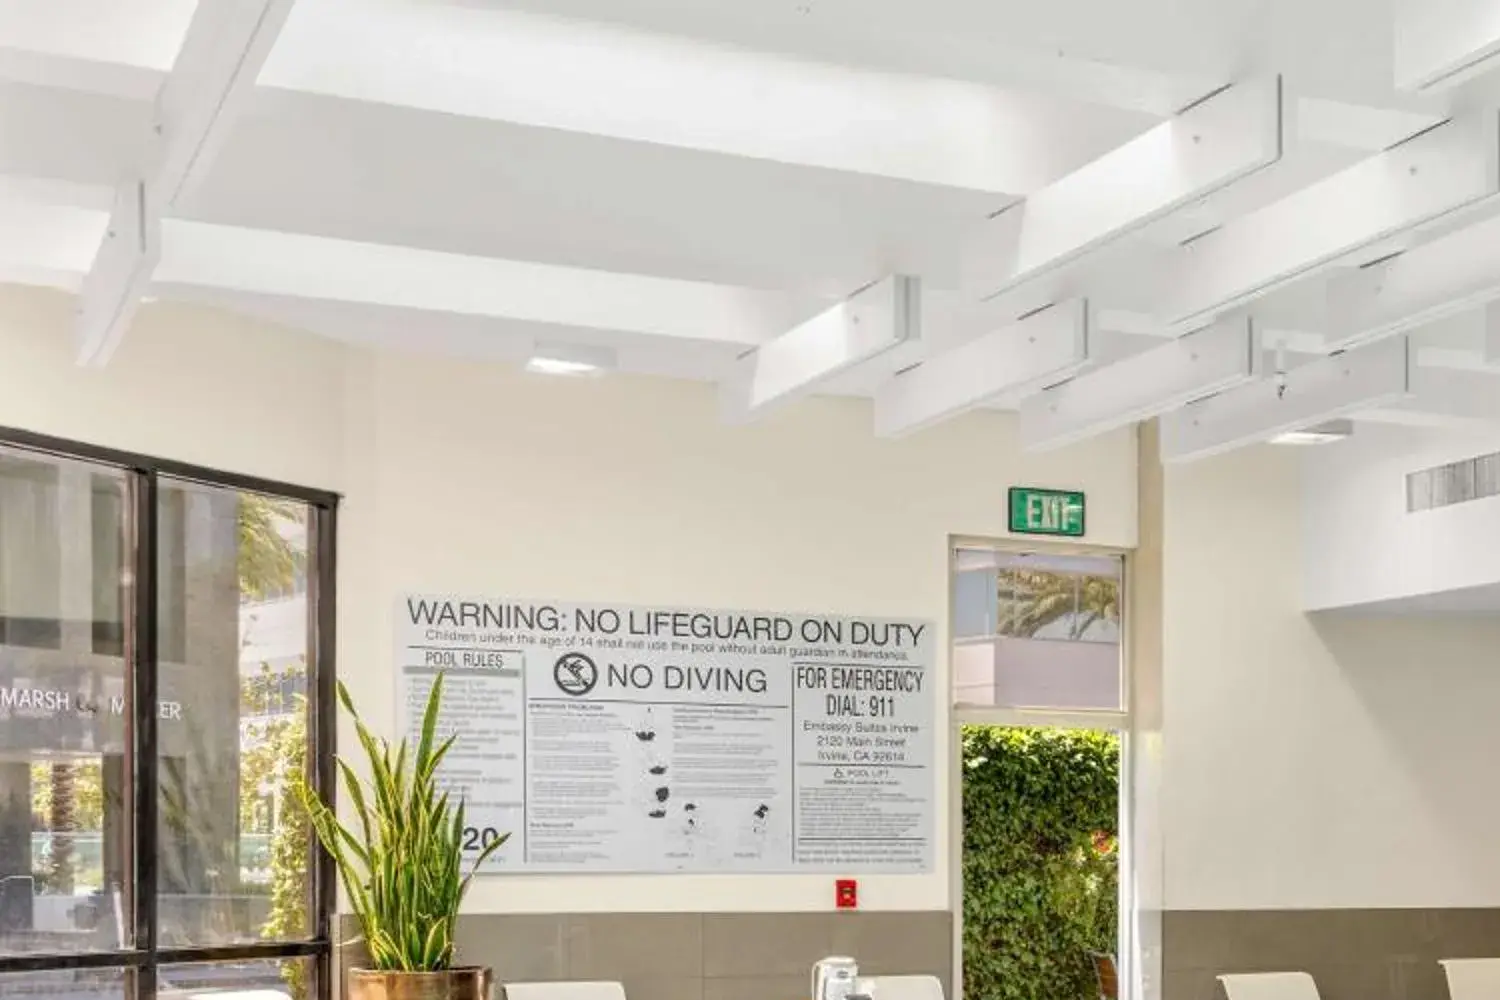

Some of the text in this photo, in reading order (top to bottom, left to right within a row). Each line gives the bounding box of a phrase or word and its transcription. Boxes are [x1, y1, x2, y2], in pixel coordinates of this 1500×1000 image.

[408, 599, 926, 648] WARNING: NO LIFEGUARD ON DUTY
[425, 629, 476, 642] Children
[480, 632, 514, 645] under
[517, 634, 536, 645] the
[540, 636, 561, 648] age
[563, 636, 576, 647] of
[580, 637, 592, 648] 14
[597, 637, 622, 649] shall
[648, 640, 668, 651] use
[671, 641, 689, 652] the
[691, 641, 714, 655] pool
[718, 642, 758, 655] without
[425, 651, 504, 668] POOL RULES
[608, 663, 767, 693] NO DIVING
[797, 666, 924, 693] FOR EMERGENCY
[1, 687, 69, 711] MARSH
[826, 693, 895, 717] DIAL: 911
[853, 750, 870, 761] CA
